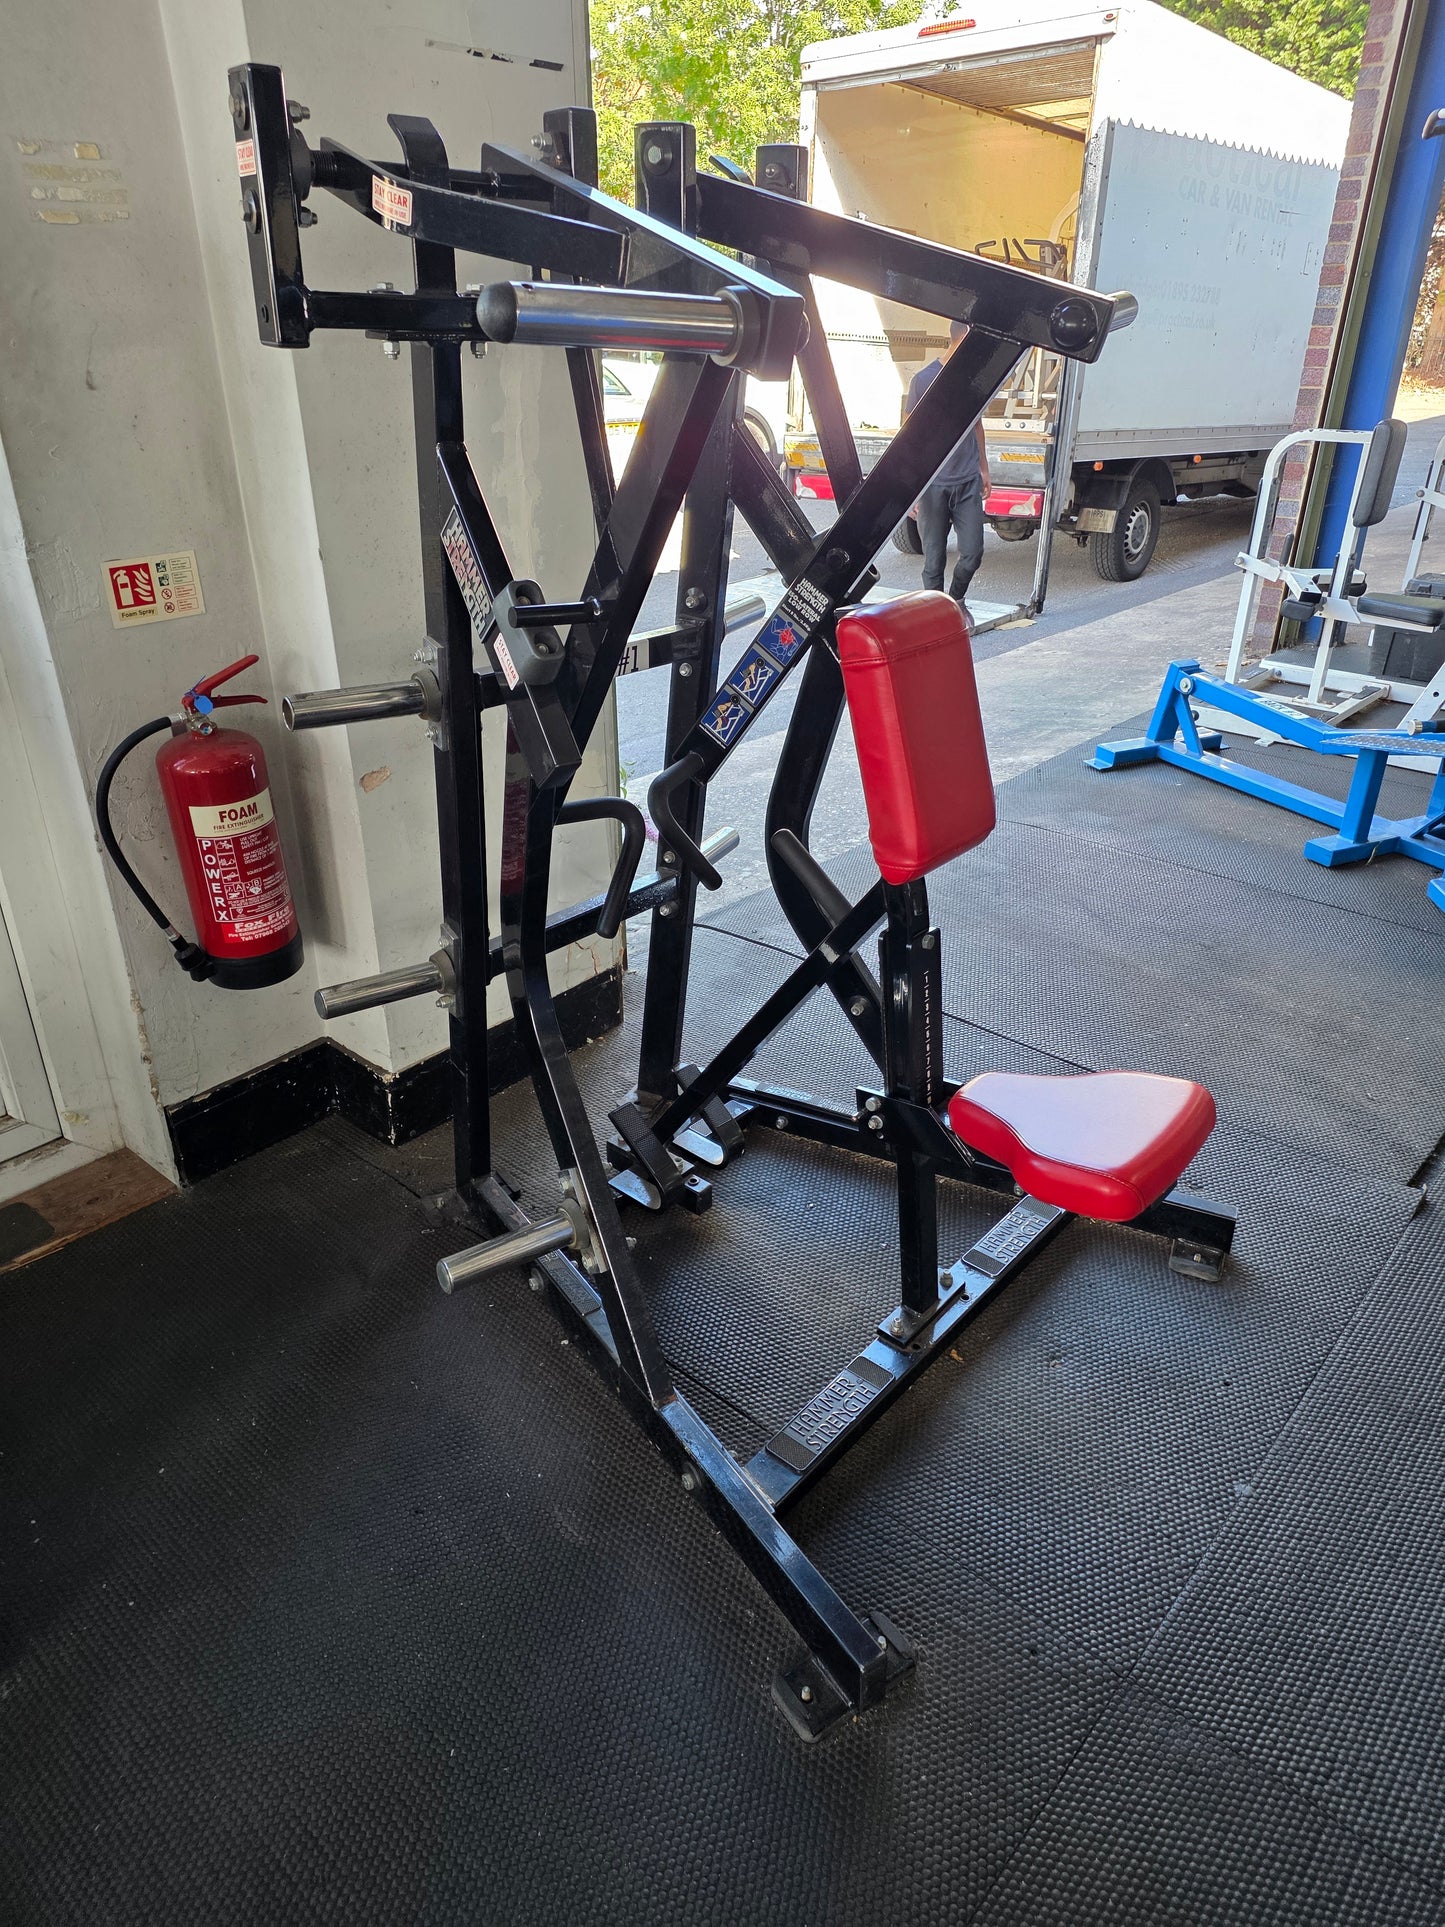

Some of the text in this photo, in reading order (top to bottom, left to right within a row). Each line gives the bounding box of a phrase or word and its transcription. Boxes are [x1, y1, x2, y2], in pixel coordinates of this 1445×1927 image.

[374, 183, 385, 199] STAY
[386, 190, 408, 208] CLEAR
[1179, 175, 1295, 228] CAR & VAN RENTAL
[445, 519, 493, 616] HAMMER
[443, 534, 486, 636] STRENGTH
[794, 583, 827, 614] STRENGTH
[799, 577, 829, 606] HAMMER
[121, 609, 155, 619] Foam Spray
[787, 597, 816, 623] LOW ROW
[788, 590, 822, 622] ISO-LATERAL
[218, 801, 259, 823] FOAM
[226, 813, 265, 830] EXTINGUISHER
[254, 879, 260, 887] B
[234, 919, 266, 931] Fox
[979, 1211, 1029, 1253] HAMMER
[994, 1213, 1049, 1264] STRENGTH
[789, 1376, 856, 1437] HAMMER
[806, 1383, 877, 1451] STRENGTH
